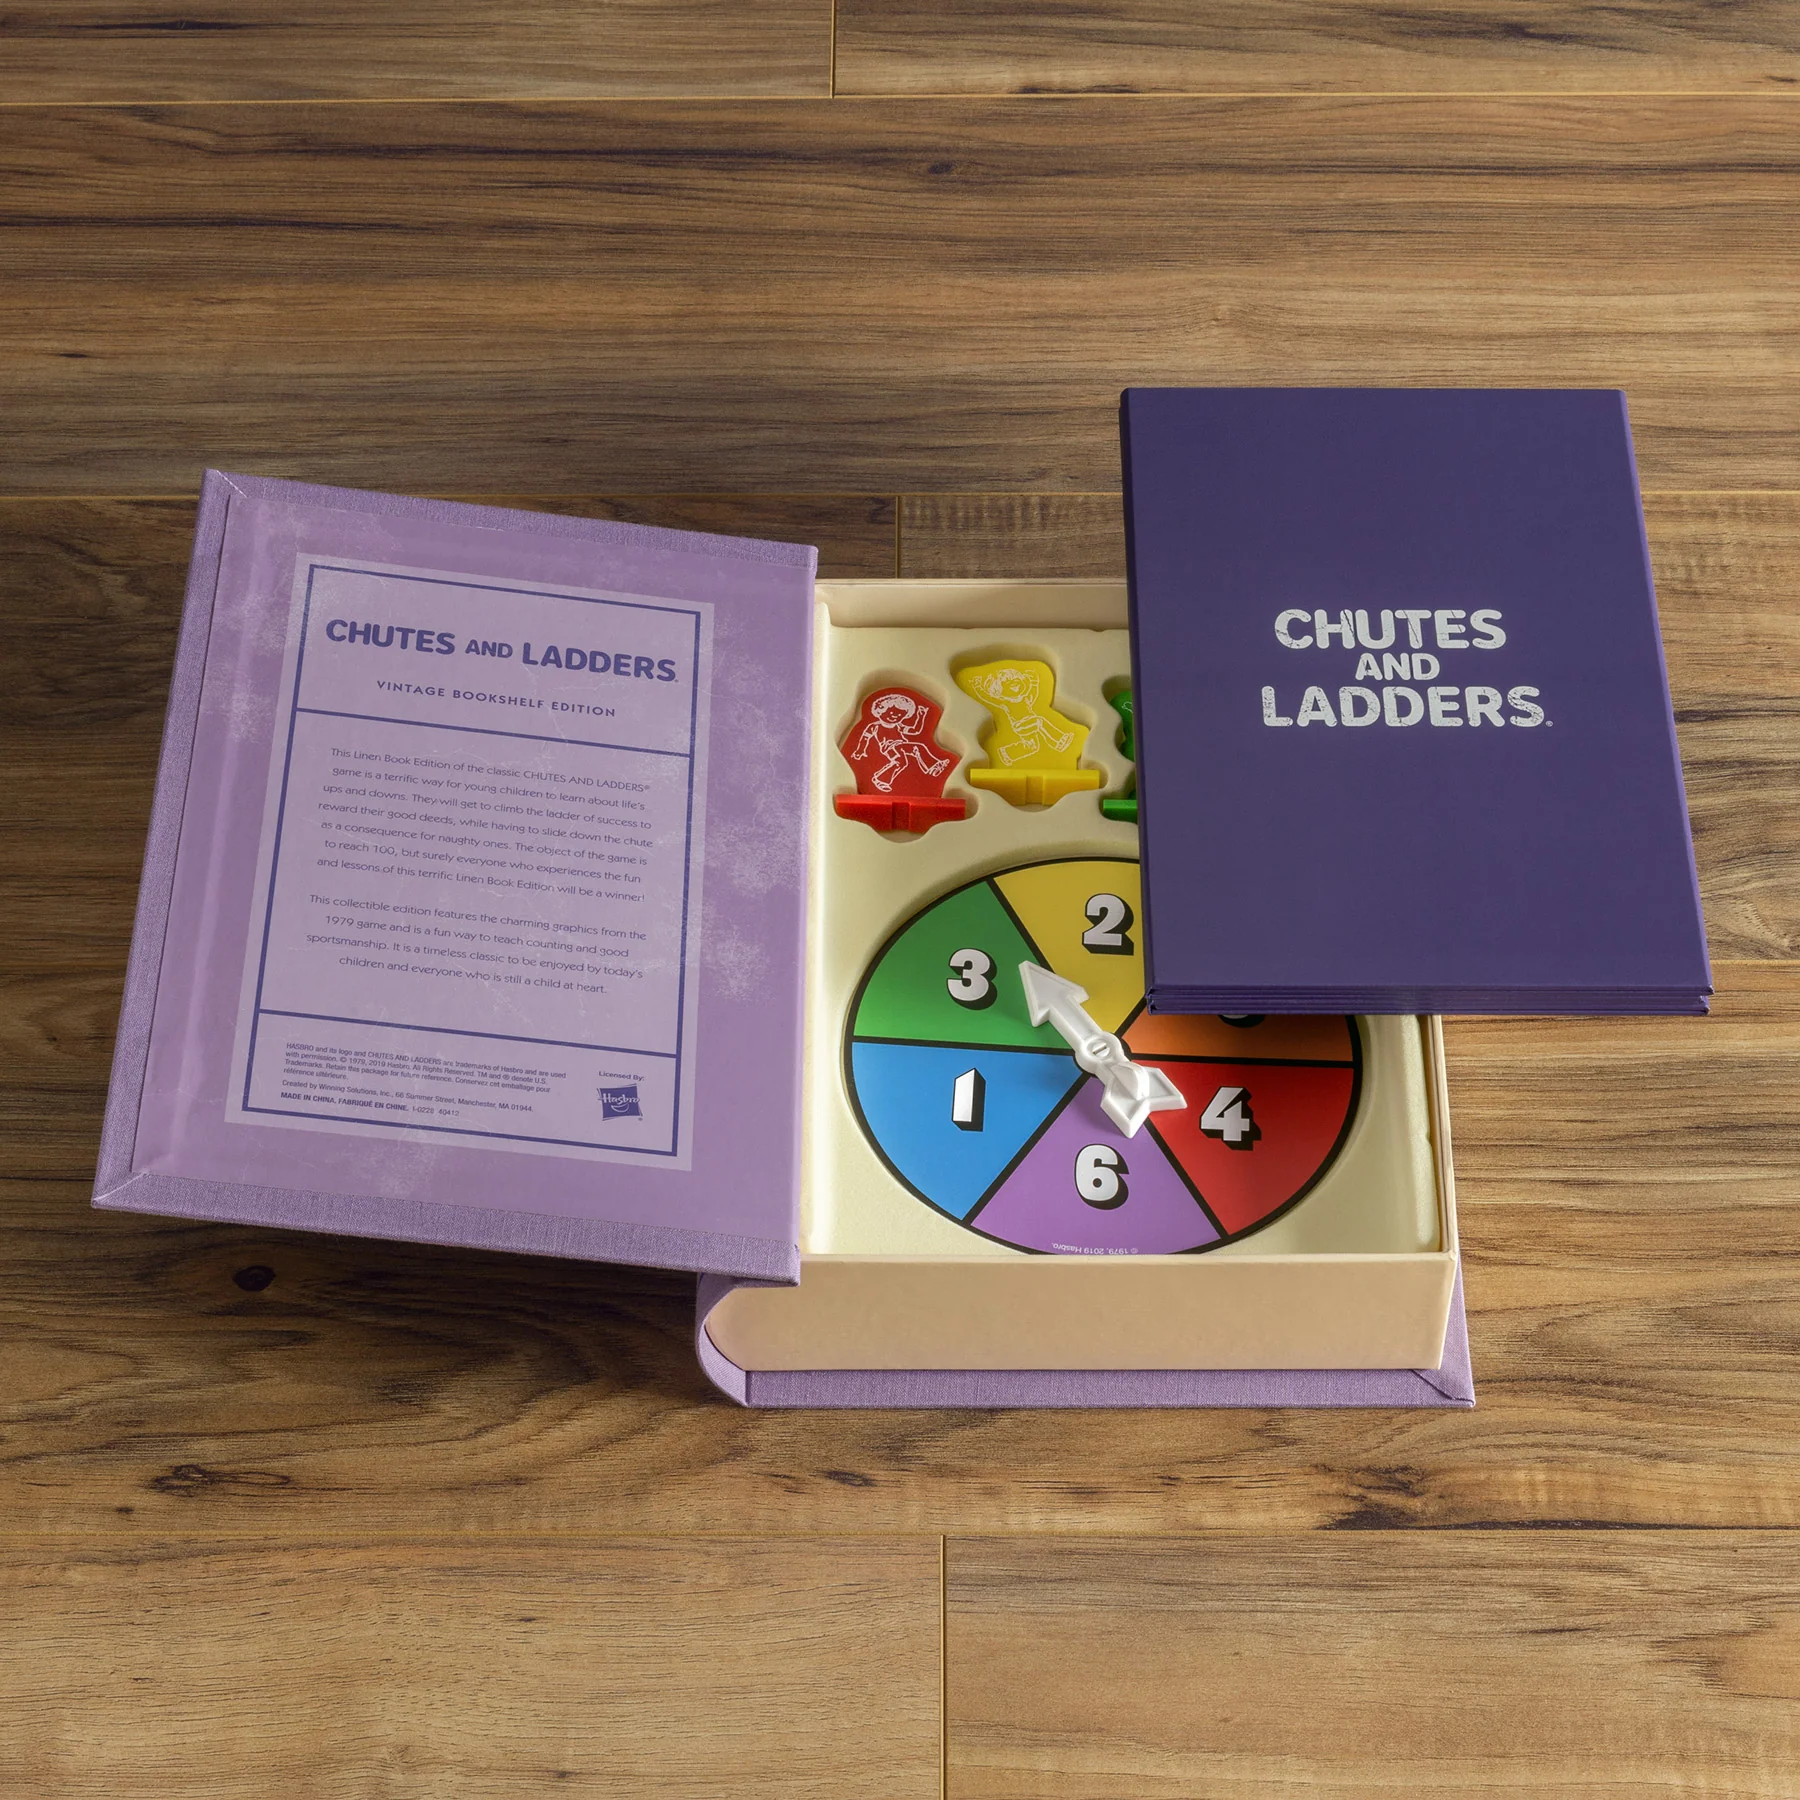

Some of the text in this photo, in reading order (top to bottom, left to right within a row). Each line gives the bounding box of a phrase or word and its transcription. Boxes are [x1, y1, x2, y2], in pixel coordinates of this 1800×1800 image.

[325, 619, 455, 654] CHUTES
[464, 639, 513, 658] AND
[1274, 609, 1506, 649] CHUTES
[1355, 653, 1440, 680] AND
[376, 679, 615, 717] VINTAGE BOOKSHELF EDITION
[331, 747, 351, 757] This
[353, 750, 381, 761] Linen
[383, 753, 410, 764] Book
[413, 757, 450, 769] Edition
[452, 762, 465, 770] of
[467, 763, 484, 773] the
[486, 766, 520, 777] classic
[522, 770, 566, 782] CHUTES
[568, 775, 593, 786] AND
[332, 767, 362, 777] game
[364, 770, 372, 778] is
[384, 772, 418, 784] terrific
[421, 778, 444, 787] way
[446, 779, 461, 788] for
[463, 783, 496, 794] young
[499, 785, 542, 797] children
[545, 791, 557, 799] to
[559, 792, 585, 803] learn
[587, 796, 618, 807] about
[317, 802, 653, 847] reward their good deeds, while having to slide down the chute
[322, 785, 651, 829] ups and downs. They will get to climb the ladder of success to
[320, 821, 332, 829] as
[344, 824, 417, 838] consequence
[420, 831, 435, 840] for
[438, 835, 480, 847] naughty
[482, 840, 511, 849] ones.
[514, 841, 534, 852] The
[536, 844, 571, 856] object
[573, 849, 585, 858] of
[587, 850, 604, 860] the
[607, 854, 636, 864] game
[639, 856, 647, 865] is
[324, 839, 640, 883] to reach 100, but surely everyone who experiences the fun
[316, 858, 338, 867] and
[340, 859, 380, 872] lessons
[382, 864, 394, 873] of
[396, 866, 415, 876] this
[418, 869, 453, 880] terrific
[455, 872, 484, 883] Linen
[486, 876, 513, 887] Book
[516, 879, 554, 891] Edition
[556, 885, 575, 894] will
[578, 886, 593, 896] be
[604, 891, 644, 902] winner!
[311, 894, 646, 940] This collectible edition features the charming graphics from the
[325, 915, 629, 957] 1979 game and is a fun way to teach counting and good
[1082, 893, 1130, 952] 2
[306, 934, 389, 950] sportsmanship.
[392, 942, 400, 951] It
[403, 943, 411, 952] is
[423, 946, 466, 958] timeless
[468, 951, 504, 962] classic
[507, 955, 519, 964] to
[521, 956, 536, 966] be
[539, 960, 584, 971] enjoyed
[586, 963, 601, 974] by
[338, 956, 607, 993] children and everyone who is still a child at heart.
[947, 948, 995, 1007] 3
[598, 1071, 631, 1079] Licensed
[280, 1091, 301, 1100] MADE
[312, 1094, 336, 1103] CHINA.
[385, 1102, 408, 1111] CHINE.
[602, 1093, 640, 1105] Hasbro
[952, 1068, 983, 1129] 1
[1200, 1086, 1258, 1147] 4
[1074, 1144, 1126, 1207] 6
[1083, 1247, 1105, 1255] 2019
